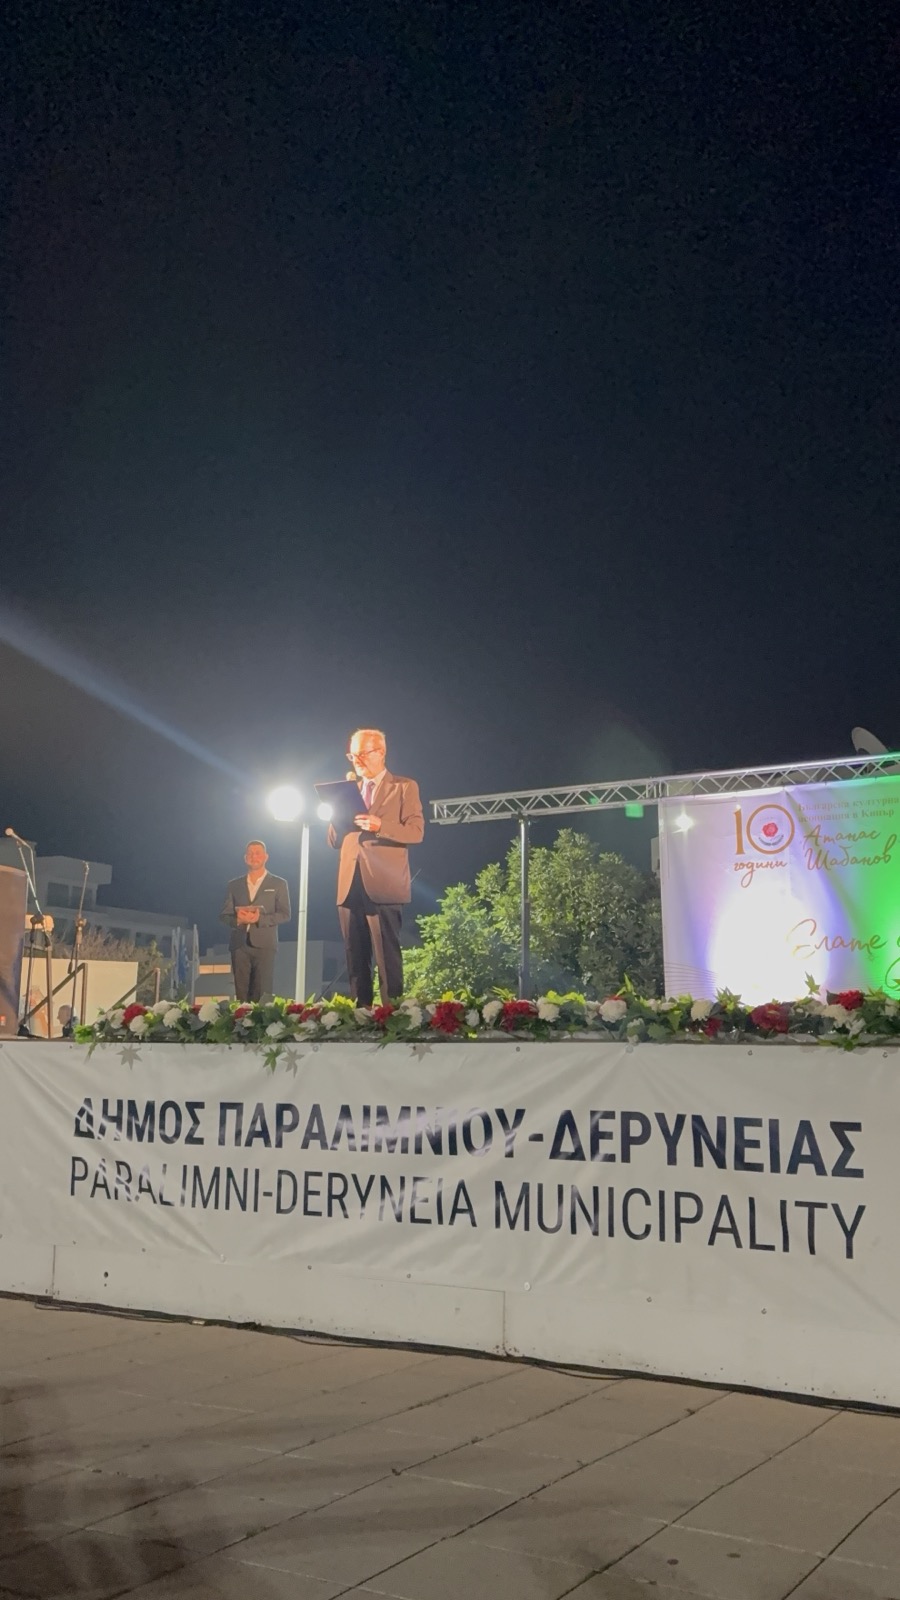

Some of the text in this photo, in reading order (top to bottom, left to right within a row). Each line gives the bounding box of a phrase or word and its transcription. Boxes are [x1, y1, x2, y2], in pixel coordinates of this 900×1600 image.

[803, 824, 881, 850] Атанас
[804, 833, 897, 871] Шабанов
[734, 861, 788, 889] години
[73, 1097, 865, 1179] ΔΗΜΟΣ ΠΑΡΑΛΙΜΝΙΟΥ-ΔΕΡΥΝΕΙΑΣ
[70, 1156, 867, 1260] PARALIMNI-DERYNEIA MUNICIPALITY
